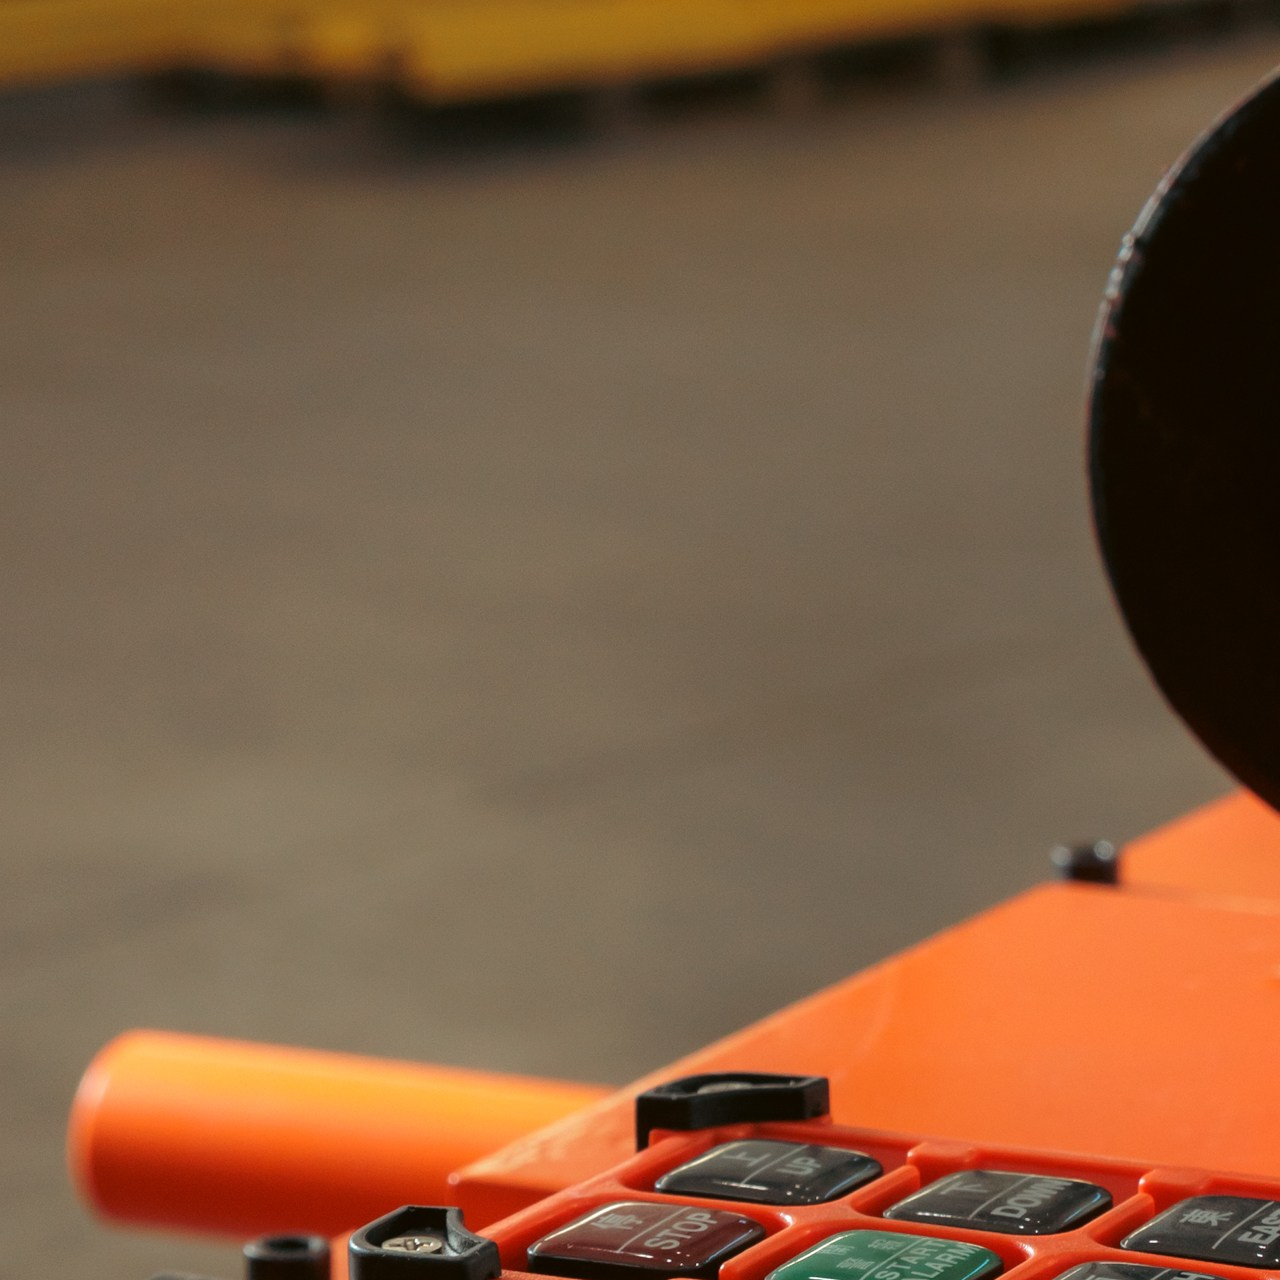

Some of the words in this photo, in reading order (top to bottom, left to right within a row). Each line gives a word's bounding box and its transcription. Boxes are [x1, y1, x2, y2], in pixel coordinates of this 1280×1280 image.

[722, 1151, 771, 1168] 上
[776, 1156, 822, 1176] UP
[940, 1181, 990, 1195] 下
[990, 1179, 1073, 1219] DOWN
[644, 1212, 718, 1250] STOP
[874, 1240, 948, 1280] START
